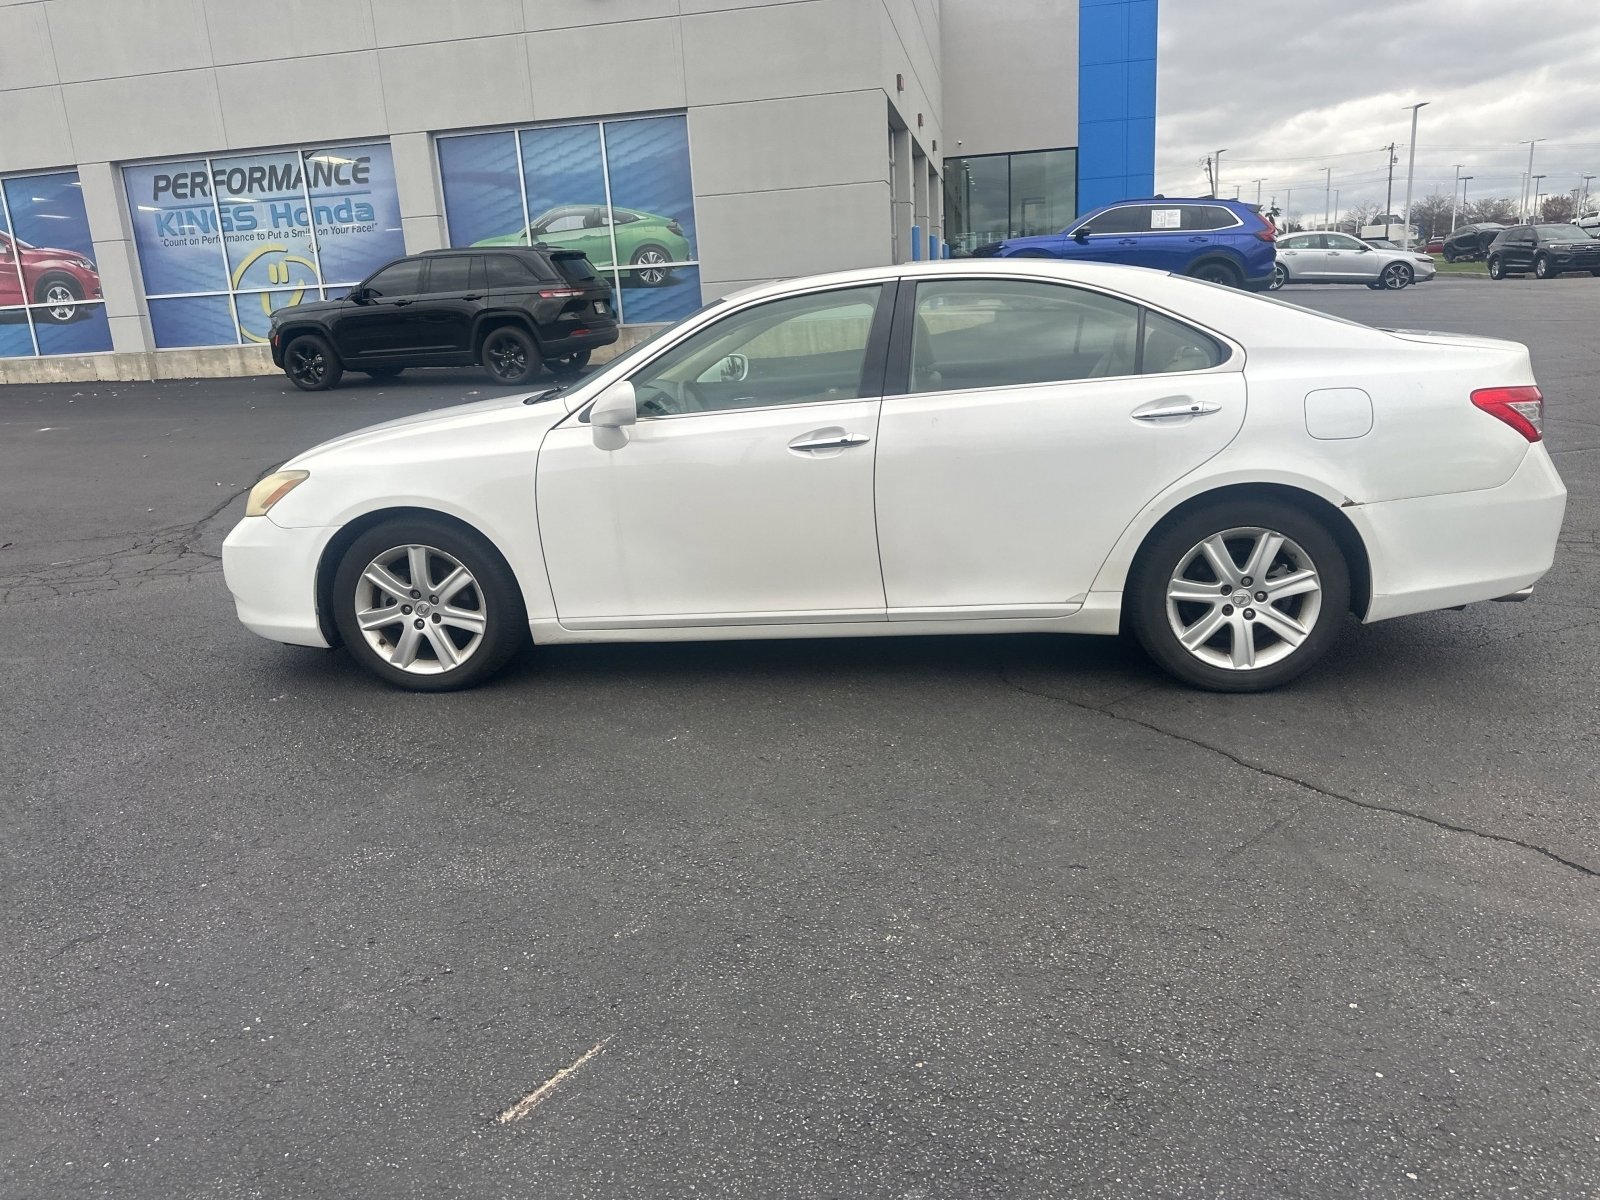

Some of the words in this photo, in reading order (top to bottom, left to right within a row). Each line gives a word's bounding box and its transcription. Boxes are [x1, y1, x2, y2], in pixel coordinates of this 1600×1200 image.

[153, 156, 371, 202] PERFORMANCE
[155, 205, 258, 237] KINGS
[269, 197, 375, 229] Honda
[189, 237, 200, 246] on
[256, 231, 266, 240] to
[267, 230, 282, 240] Put
[283, 230, 290, 239] a
[317, 226, 328, 236] on
[330, 224, 350, 235] Your
